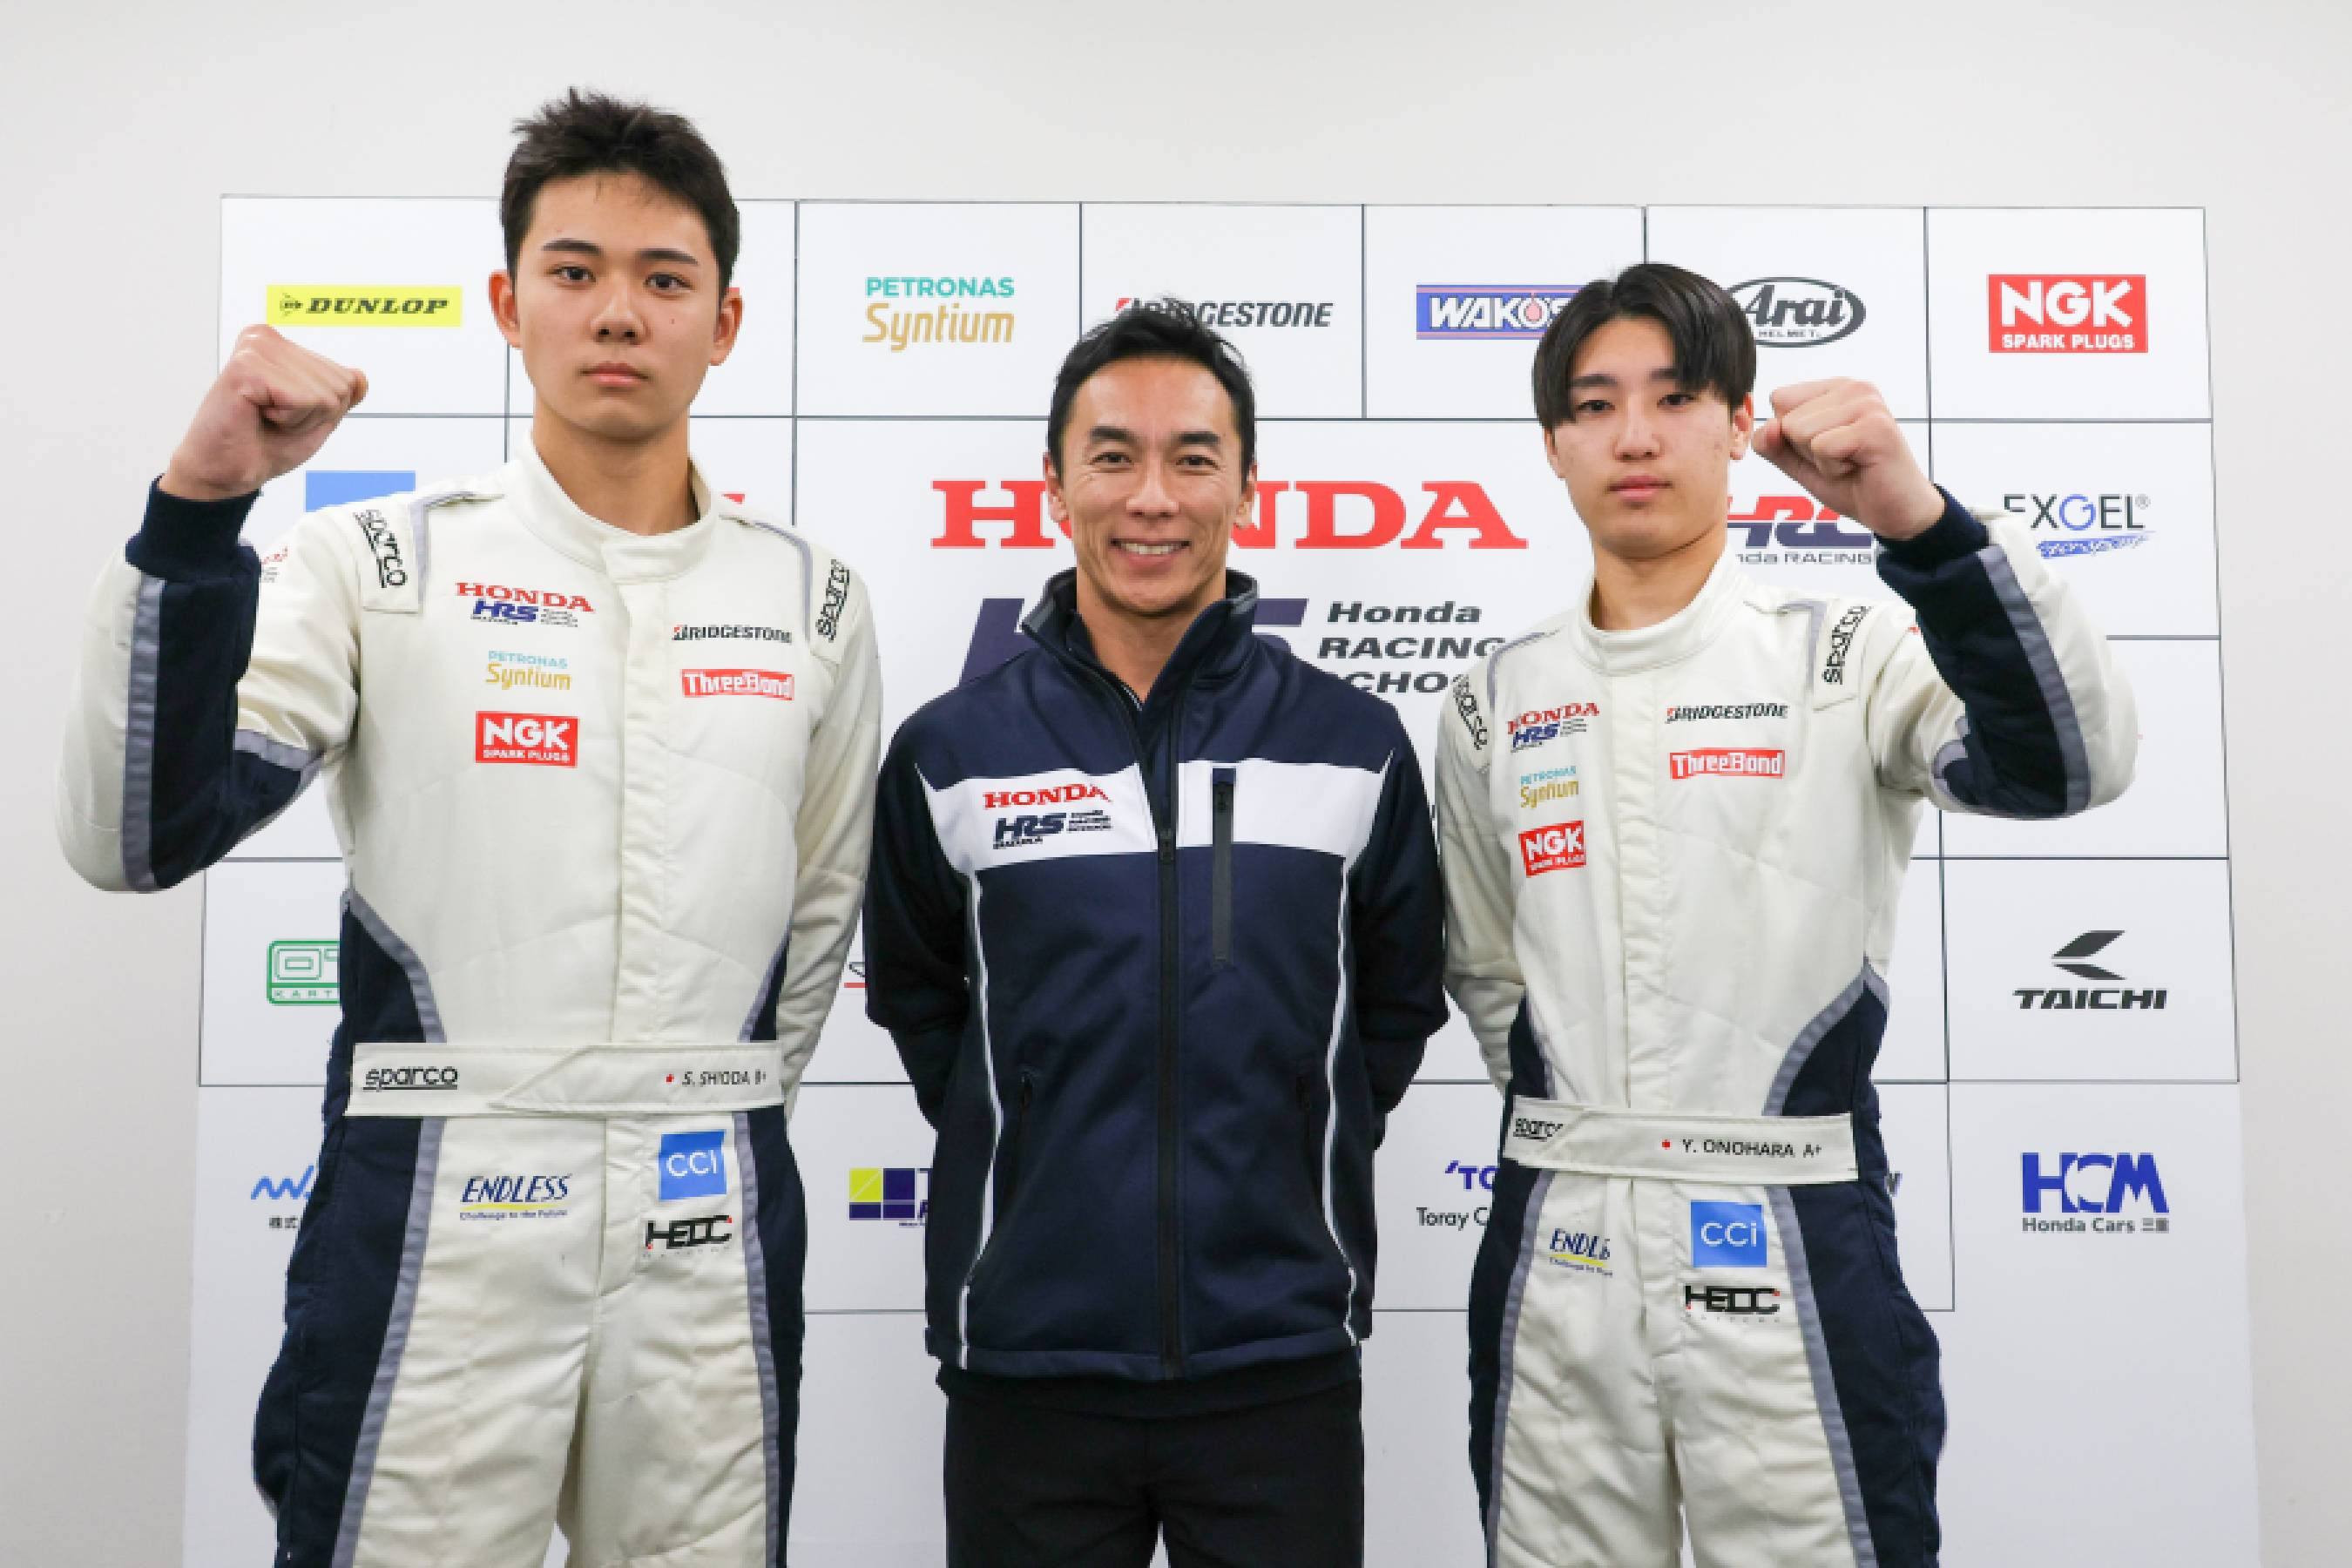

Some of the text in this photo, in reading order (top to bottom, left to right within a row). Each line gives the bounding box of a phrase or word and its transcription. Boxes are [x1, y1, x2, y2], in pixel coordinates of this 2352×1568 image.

[866, 276, 1015, 298] PETRONAS
[306, 297, 449, 314] DUNLOP
[1115, 298, 1334, 328] GESTONE
[1744, 284, 1846, 328] Arai
[2001, 280, 2133, 328] NGK
[862, 302, 1014, 352] Syntium
[2002, 334, 2134, 349] SPARK PLUGS
[931, 480, 1528, 550] HDA
[1784, 552, 1873, 565] RACING
[456, 582, 597, 613] HONDA
[473, 599, 539, 622] HRS
[1327, 601, 1482, 624] Honda
[672, 625, 793, 645] BRIDGESTONE
[488, 651, 569, 669] PETRONAS
[1318, 637, 1505, 659] RACING
[485, 663, 572, 690] Syntium
[683, 672, 793, 698] ThreeBond
[1343, 672, 1450, 694] CHO
[1507, 702, 1599, 735] HONDA
[1665, 703, 1789, 724] BRIDGESTONE
[483, 717, 570, 751] NGK
[1512, 722, 1560, 748] HRS
[1672, 753, 1783, 777] ThreeBond
[983, 784, 1112, 809] HONDA
[996, 812, 1067, 841] HRS
[1525, 826, 1583, 861] NGK
[2014, 989, 2167, 1010] TAICHI
[362, 1067, 458, 1092] sparco
[1703, 1139, 1795, 1159] ONOHARA
[460, 1174, 572, 1203] ENDLESS
[2021, 1152, 2170, 1213] HCM
[1416, 1206, 1470, 1232] Toray
[2021, 1217, 2086, 1233] Honda
[2092, 1217, 2135, 1233] Cars
[1700, 1221, 1758, 1247] CCi
